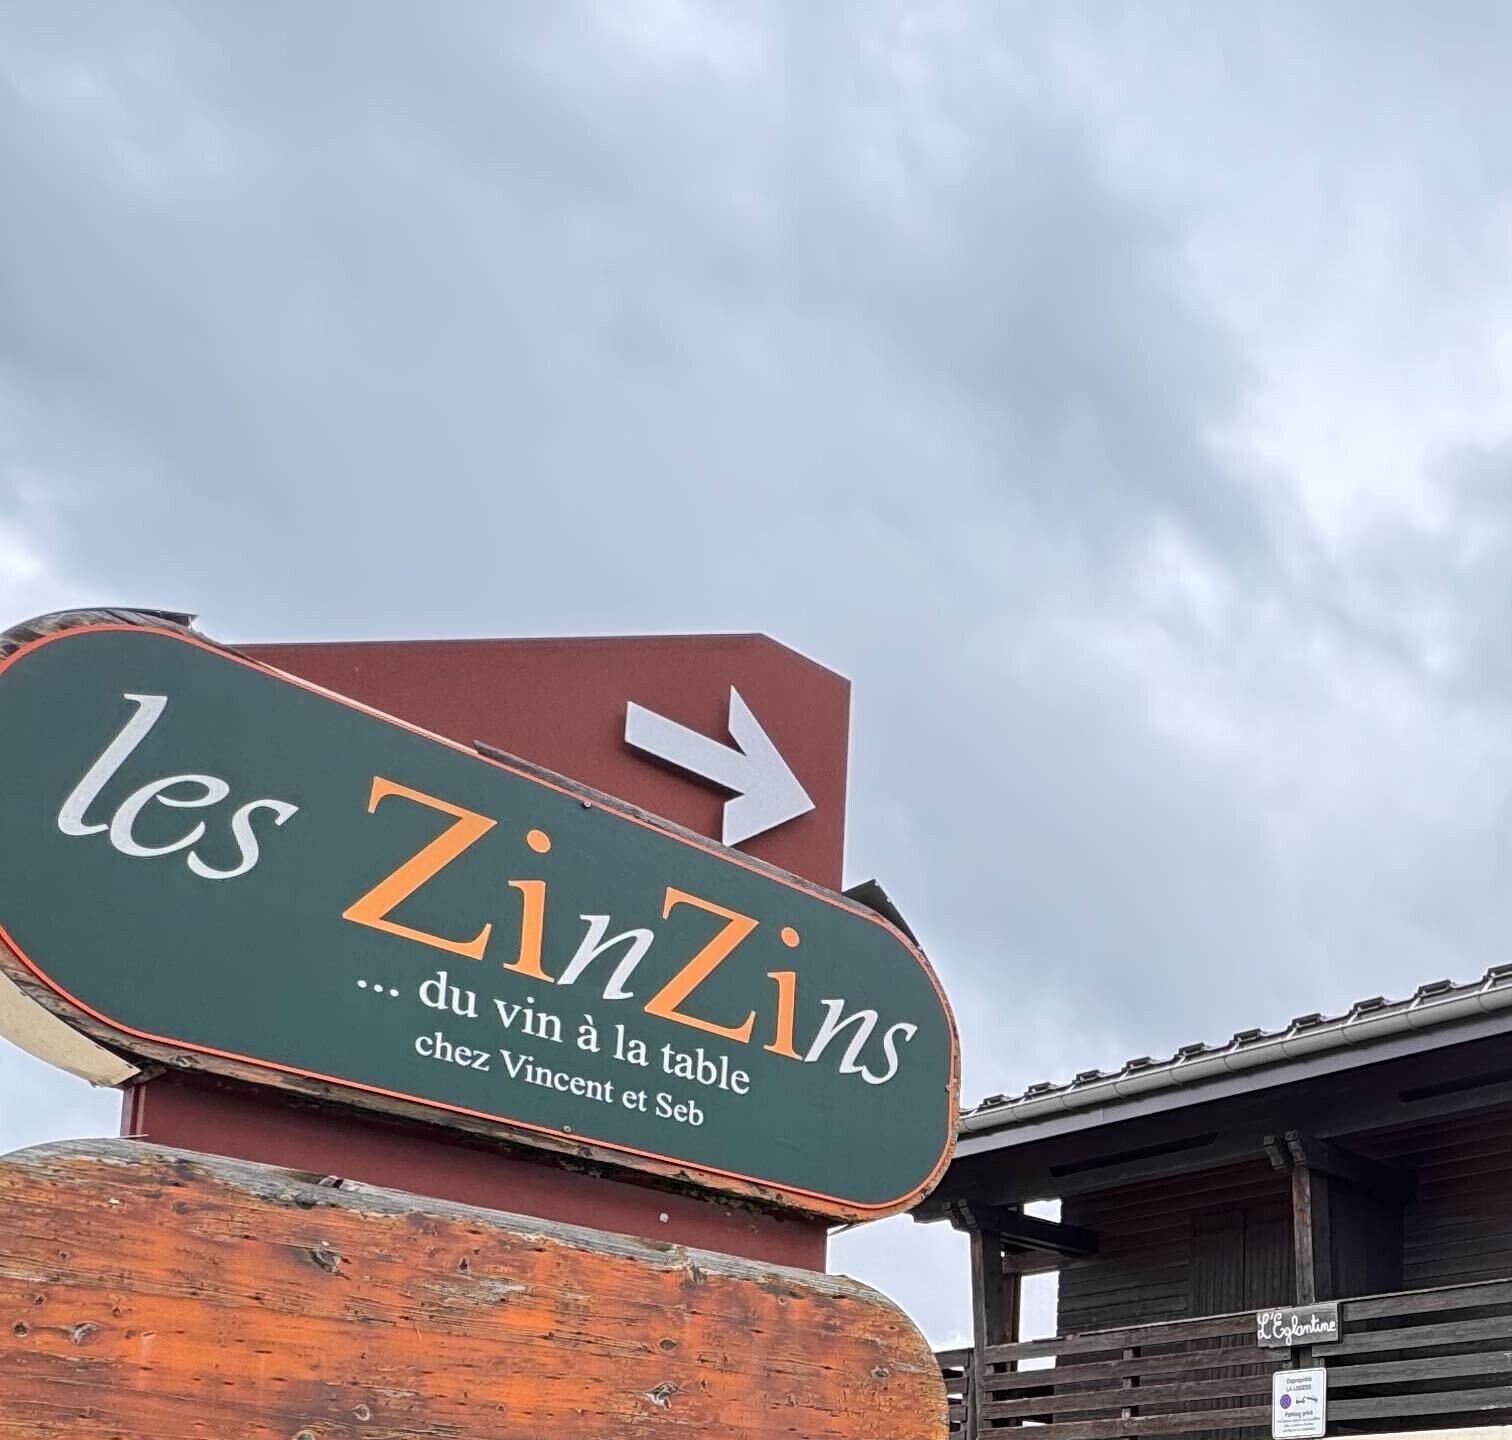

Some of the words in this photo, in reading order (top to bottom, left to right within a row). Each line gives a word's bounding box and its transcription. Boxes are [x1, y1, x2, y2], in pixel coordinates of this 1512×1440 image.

[54, 693, 300, 880] les
[342, 775, 918, 1085] ZinZins
[415, 1031, 491, 1072] chez
[499, 1048, 614, 1103] Vincent
[622, 1090, 649, 1113] et
[655, 1092, 705, 1126] Seb
[418, 971, 478, 1018] du
[493, 996, 563, 1043] vin
[577, 1014, 601, 1053] à
[614, 1025, 650, 1067] la
[661, 1043, 751, 1095] table
